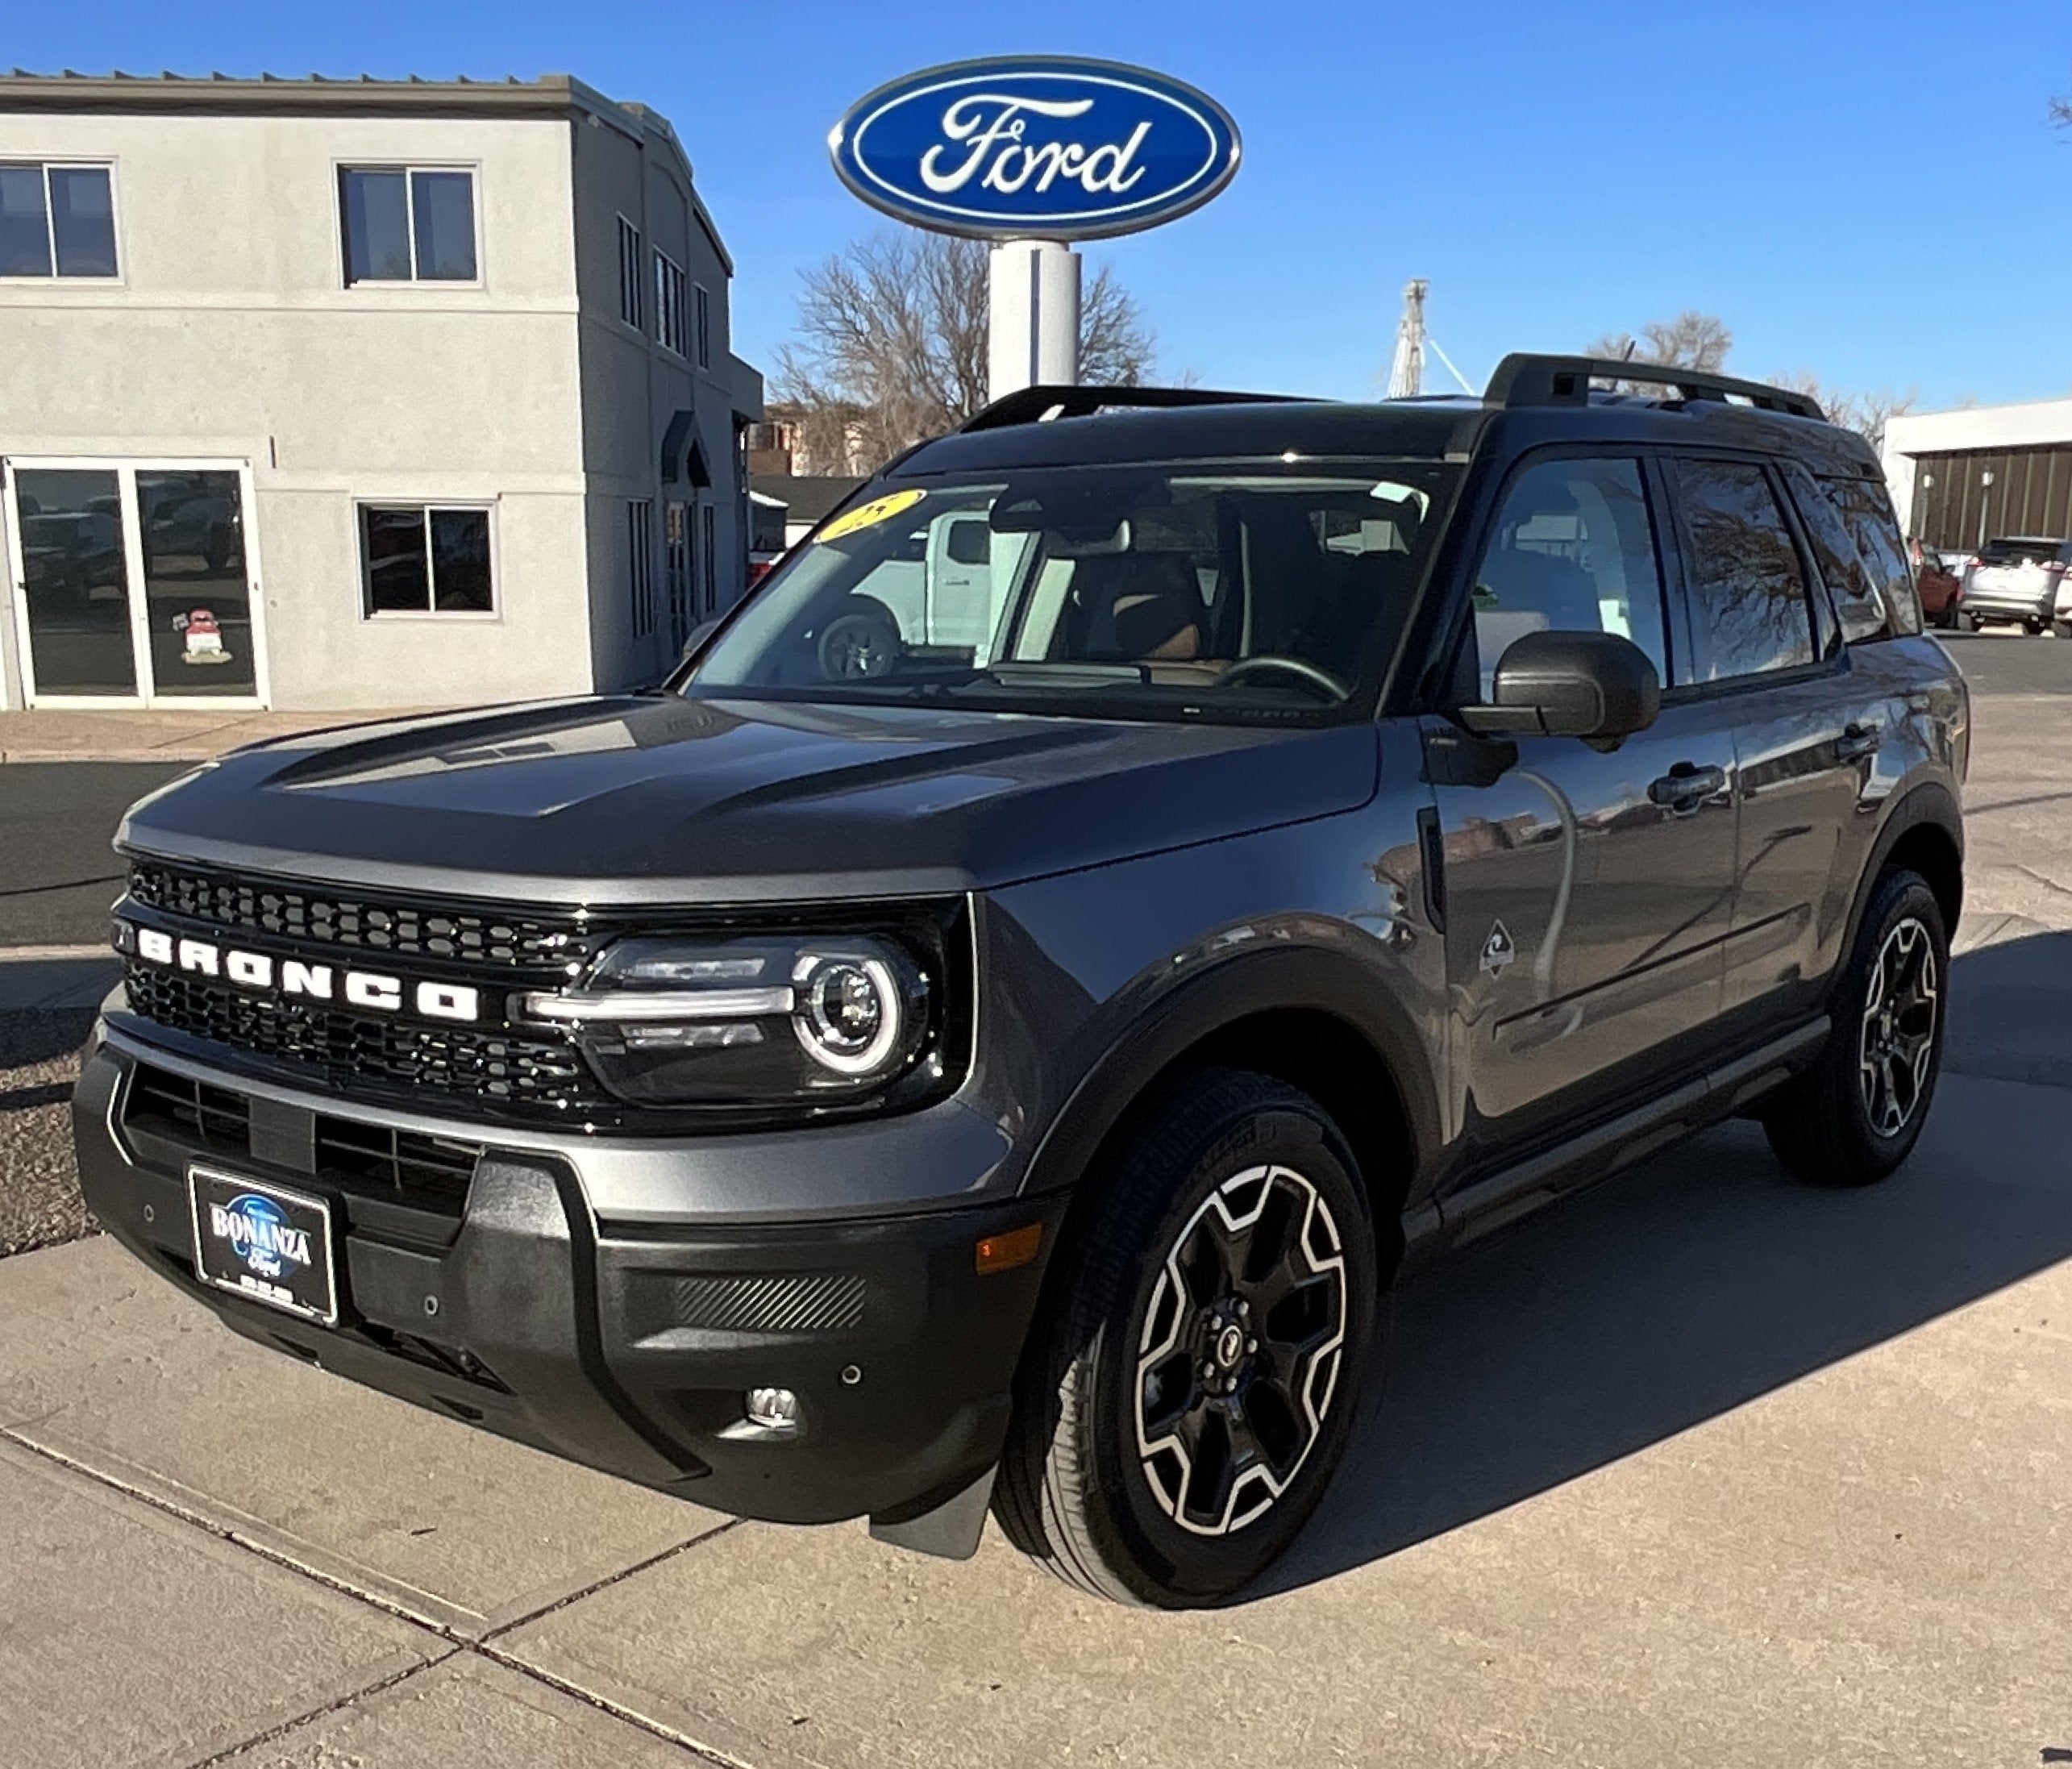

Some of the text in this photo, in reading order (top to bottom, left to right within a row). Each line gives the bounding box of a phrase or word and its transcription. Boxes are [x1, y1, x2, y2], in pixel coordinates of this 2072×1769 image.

[921, 94, 1152, 194] Ford
[139, 930, 478, 1021] BRONCO
[209, 1203, 311, 1264] BONANZA
